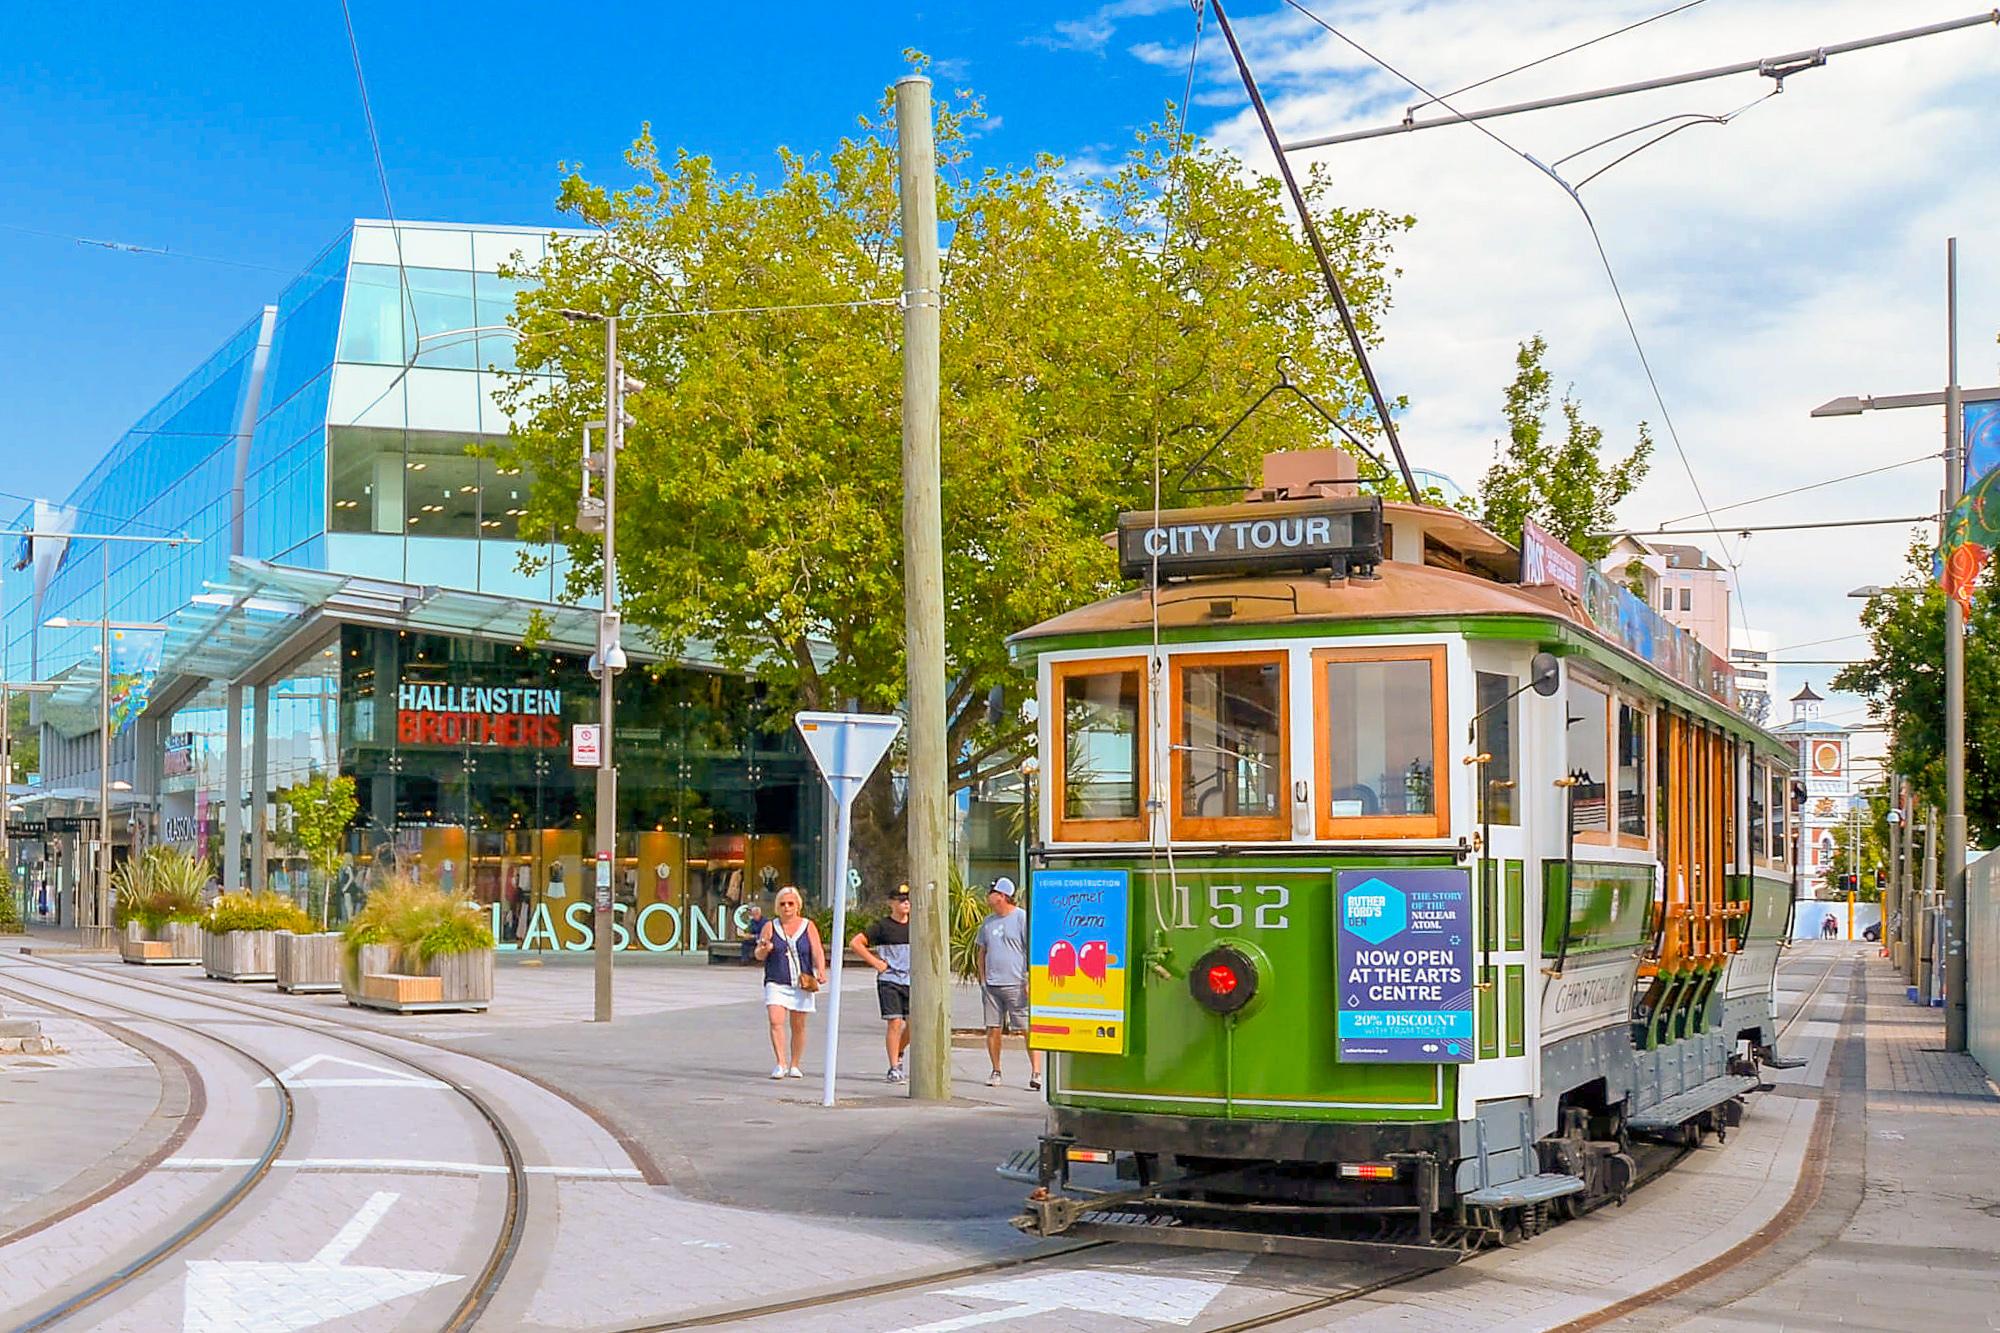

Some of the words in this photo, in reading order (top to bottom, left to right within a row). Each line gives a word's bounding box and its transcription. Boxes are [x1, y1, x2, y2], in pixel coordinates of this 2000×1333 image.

[1144, 524, 1222, 557] CITY
[1230, 517, 1331, 550] TOUR
[398, 684, 561, 715] HALLENSTEIN
[398, 710, 561, 747] BROTHERS
[1347, 895, 1386, 907] RUTHER
[1411, 892, 1431, 901] THE
[1431, 892, 1464, 901] STORY
[1174, 885, 1289, 929] 152
[1347, 906, 1383, 918] FORD'S
[1411, 901, 1425, 911] OF
[1426, 901, 1446, 911] THE
[1348, 918, 1367, 927] DEN
[1411, 911, 1457, 920] NUCLEAR
[463, 902, 754, 952] LASSON
[1411, 920, 1443, 930] ATOM.
[1356, 950, 1400, 966] NOW
[1403, 950, 1454, 966] OPEN
[1348, 967, 1372, 983] AT
[1373, 967, 1412, 983] THE
[1414, 967, 1462, 983] ARTS
[1369, 985, 1442, 1001] CENTRE
[1354, 1014, 1383, 1026] 20%
[1385, 1014, 1457, 1026] DISCOUNT
